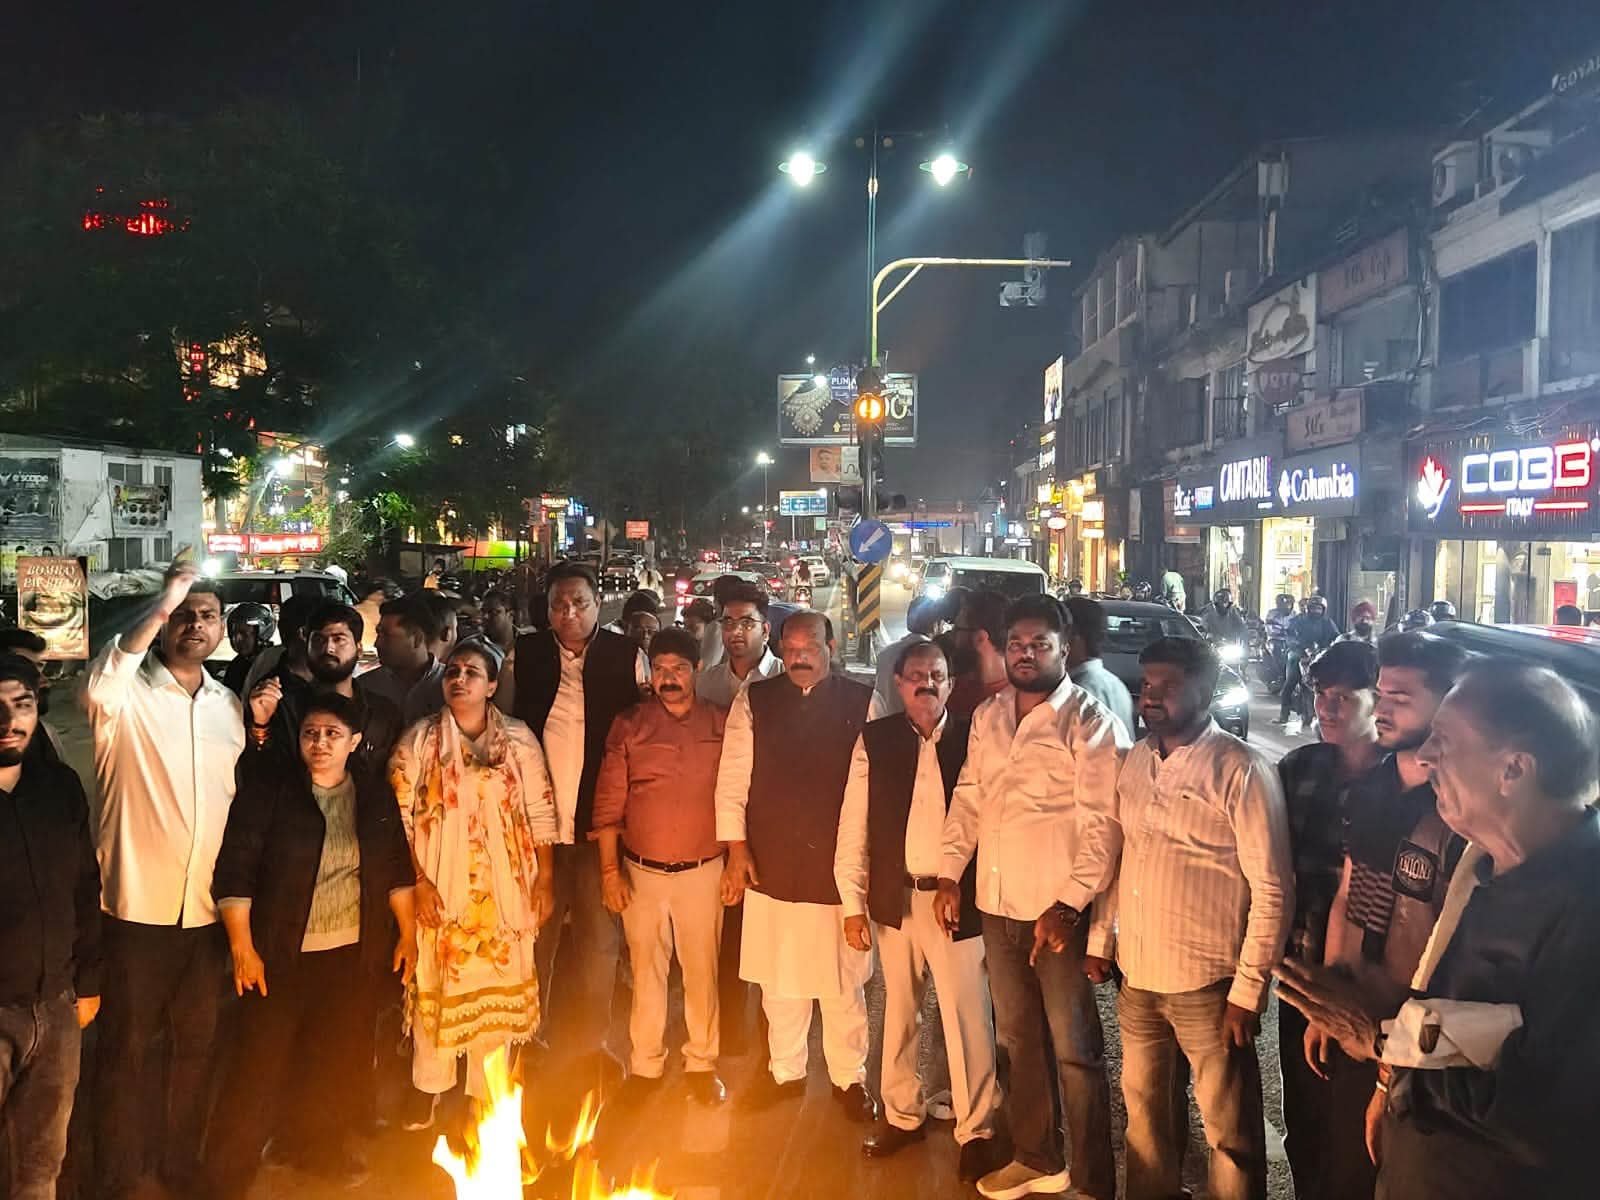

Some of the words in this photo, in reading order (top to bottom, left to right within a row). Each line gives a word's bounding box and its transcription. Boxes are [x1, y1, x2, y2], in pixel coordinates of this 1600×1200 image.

[1219, 456, 1272, 503] CANTABIL
[1291, 463, 1355, 503] Columbia
[1462, 441, 1591, 493] COBB
